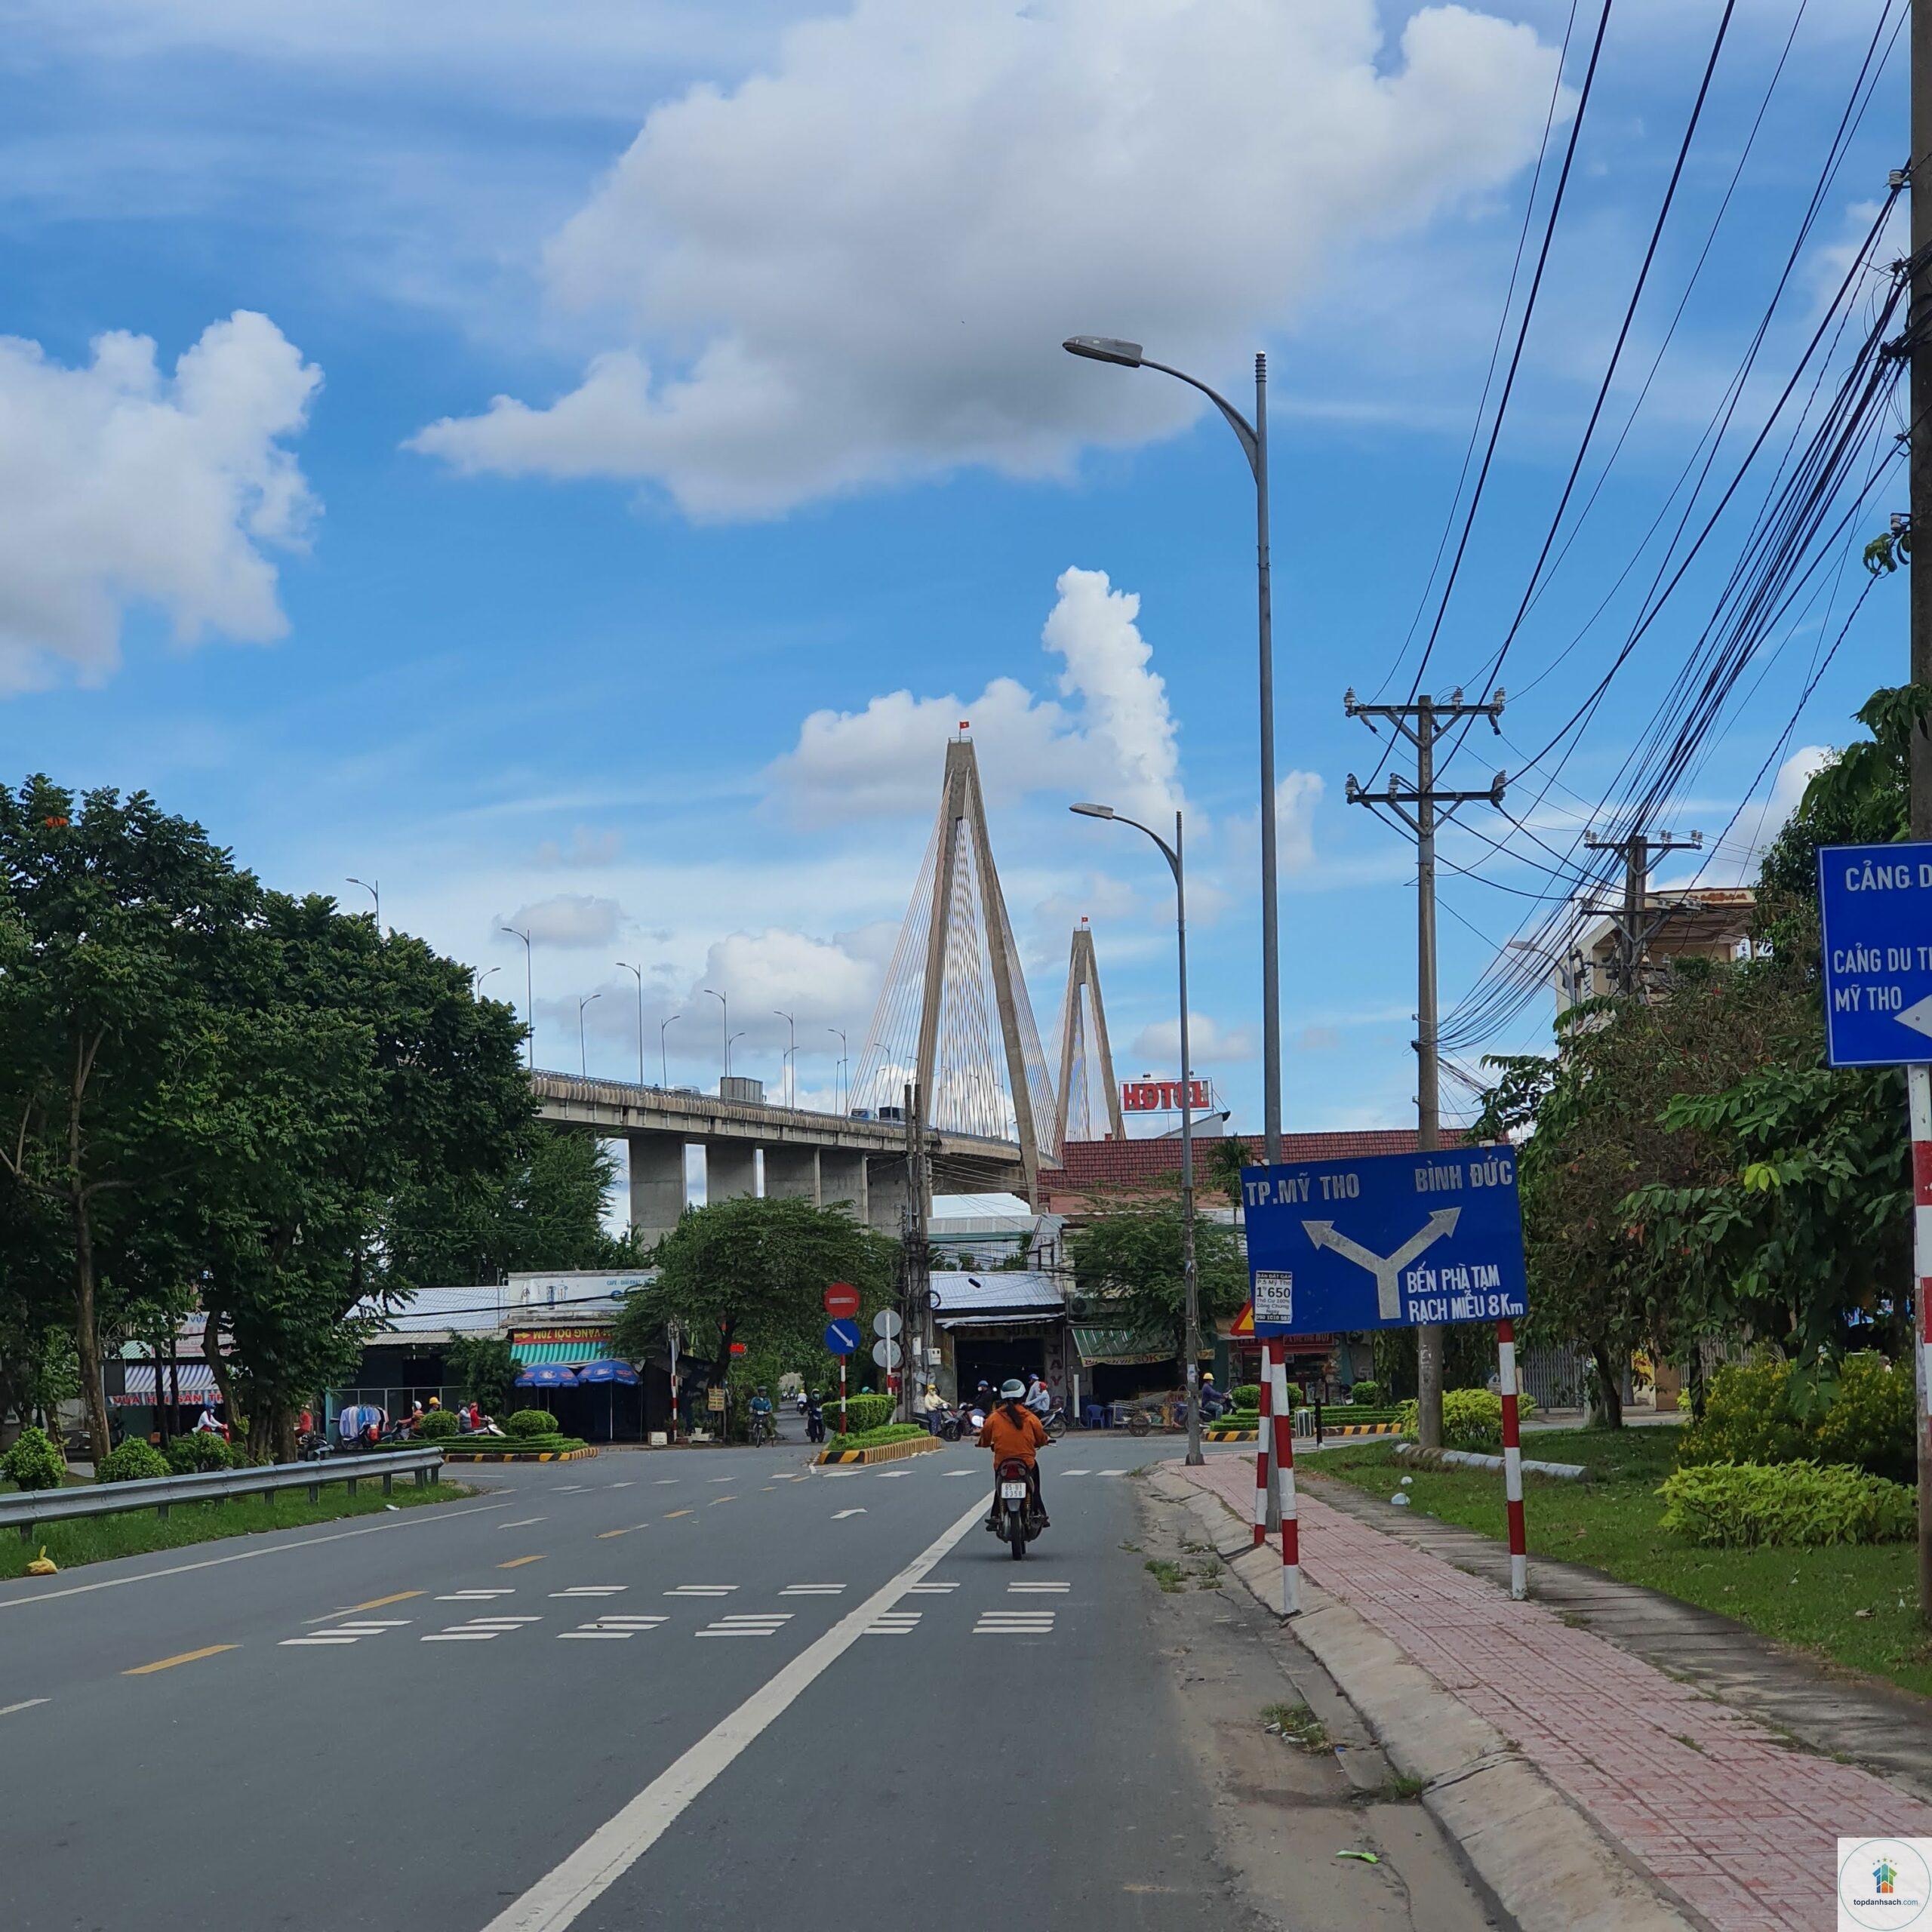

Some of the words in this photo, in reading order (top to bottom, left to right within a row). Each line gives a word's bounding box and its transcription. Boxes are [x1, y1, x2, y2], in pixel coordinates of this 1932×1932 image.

[1845, 860, 1910, 891] CẢNG
[1833, 943, 1881, 974] CẢNG
[1887, 947, 1911, 972] DU
[1835, 984, 1862, 1012] MỸ
[1866, 986, 1902, 1011] THO
[1245, 1171, 1311, 1207] TP.MỸ
[1319, 1173, 1360, 1200] THO
[1415, 1160, 1463, 1192] BÌNH
[1469, 1155, 1513, 1188] ĐỨC
[1268, 1287, 1291, 1298] 650
[1407, 1260, 1438, 1294] BẾN
[1441, 1263, 1471, 1291] PHÀ
[1471, 1264, 1500, 1291] TẠM
[1408, 1298, 1448, 1325] RẠCH
[1451, 1289, 1485, 1319] MIỄU
